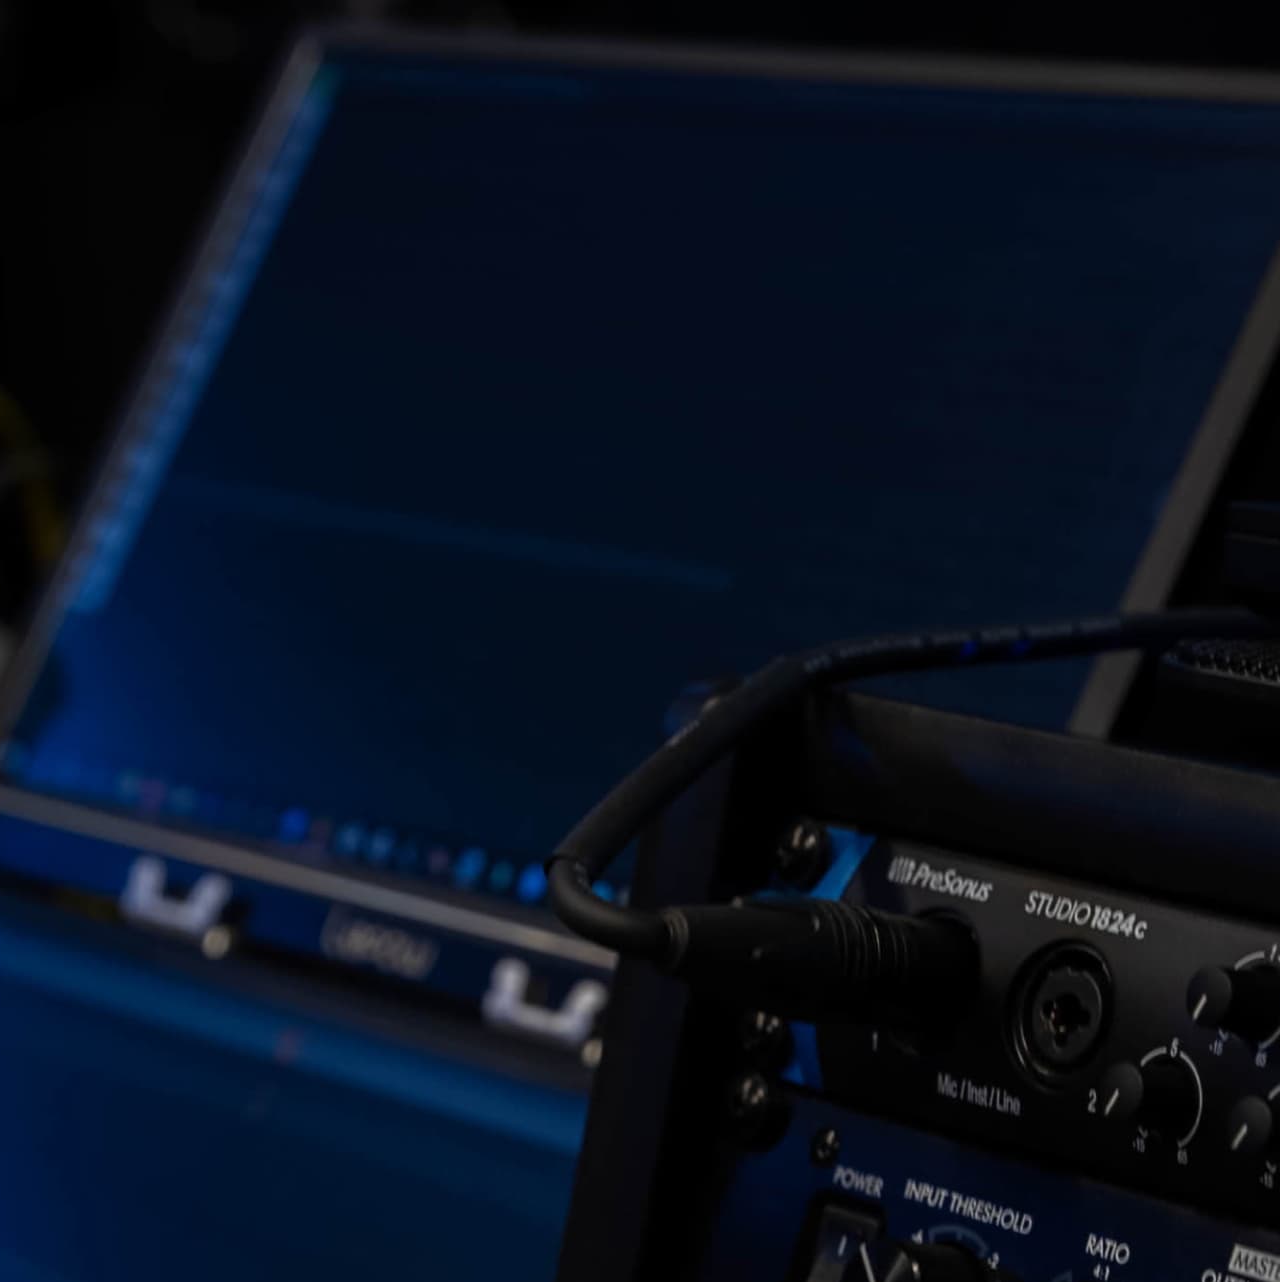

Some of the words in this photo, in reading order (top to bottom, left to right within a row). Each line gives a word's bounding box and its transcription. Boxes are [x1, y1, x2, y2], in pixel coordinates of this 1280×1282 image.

[913, 861, 993, 902] PreSonus
[1087, 1088, 1098, 1115] 2
[832, 1164, 885, 1199] POWER
[904, 1178, 949, 1209] INPUT
[949, 1190, 1033, 1236] THRESHOLD
[1085, 1232, 1131, 1265] RATIO
